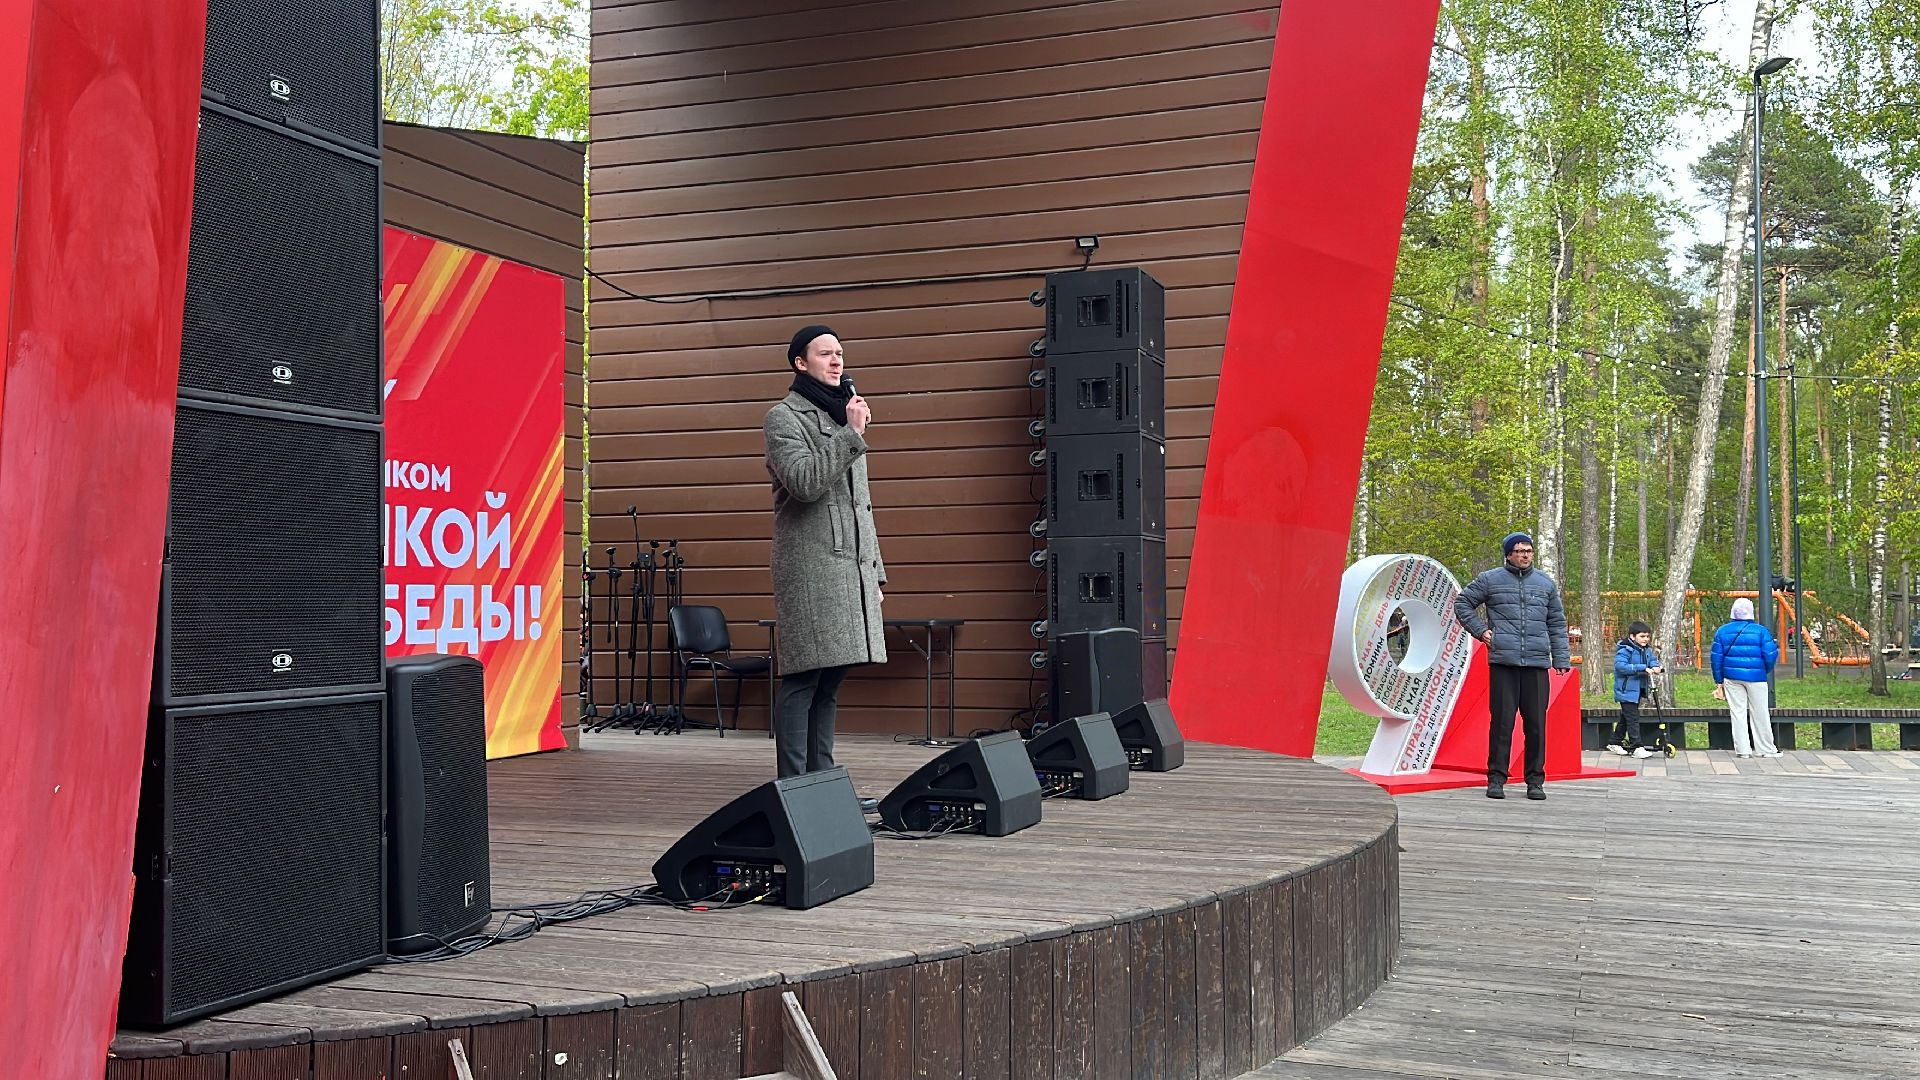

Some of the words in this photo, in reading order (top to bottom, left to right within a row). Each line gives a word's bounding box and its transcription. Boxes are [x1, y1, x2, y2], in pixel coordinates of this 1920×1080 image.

[384, 491, 511, 569] КОЙ
[1360, 639, 1373, 661] МАЯ
[1374, 600, 1389, 628] ДЕНЬ
[1384, 557, 1406, 600] ПОБЕДЫ
[1362, 636, 1384, 682] ПОМНИМ
[1373, 659, 1393, 700] СПАСИБО
[1380, 667, 1399, 704] ПОБЕДА
[1393, 675, 1412, 712] ПОМНИМ
[1405, 676, 1422, 704] МАЯ
[1412, 697, 1423, 715] ДЕНЬ
[1419, 667, 1434, 696] ПОБЕДЫ
[1398, 759, 1409, 771] С
[1404, 663, 1446, 758] ПРАЗДНИКОМ
[1401, 706, 1410, 714] 9
[1414, 741, 1426, 762] МАЯ
[1426, 703, 1440, 729] ДЕНЬ
[1436, 662, 1455, 702] ПОБЕДЫ
